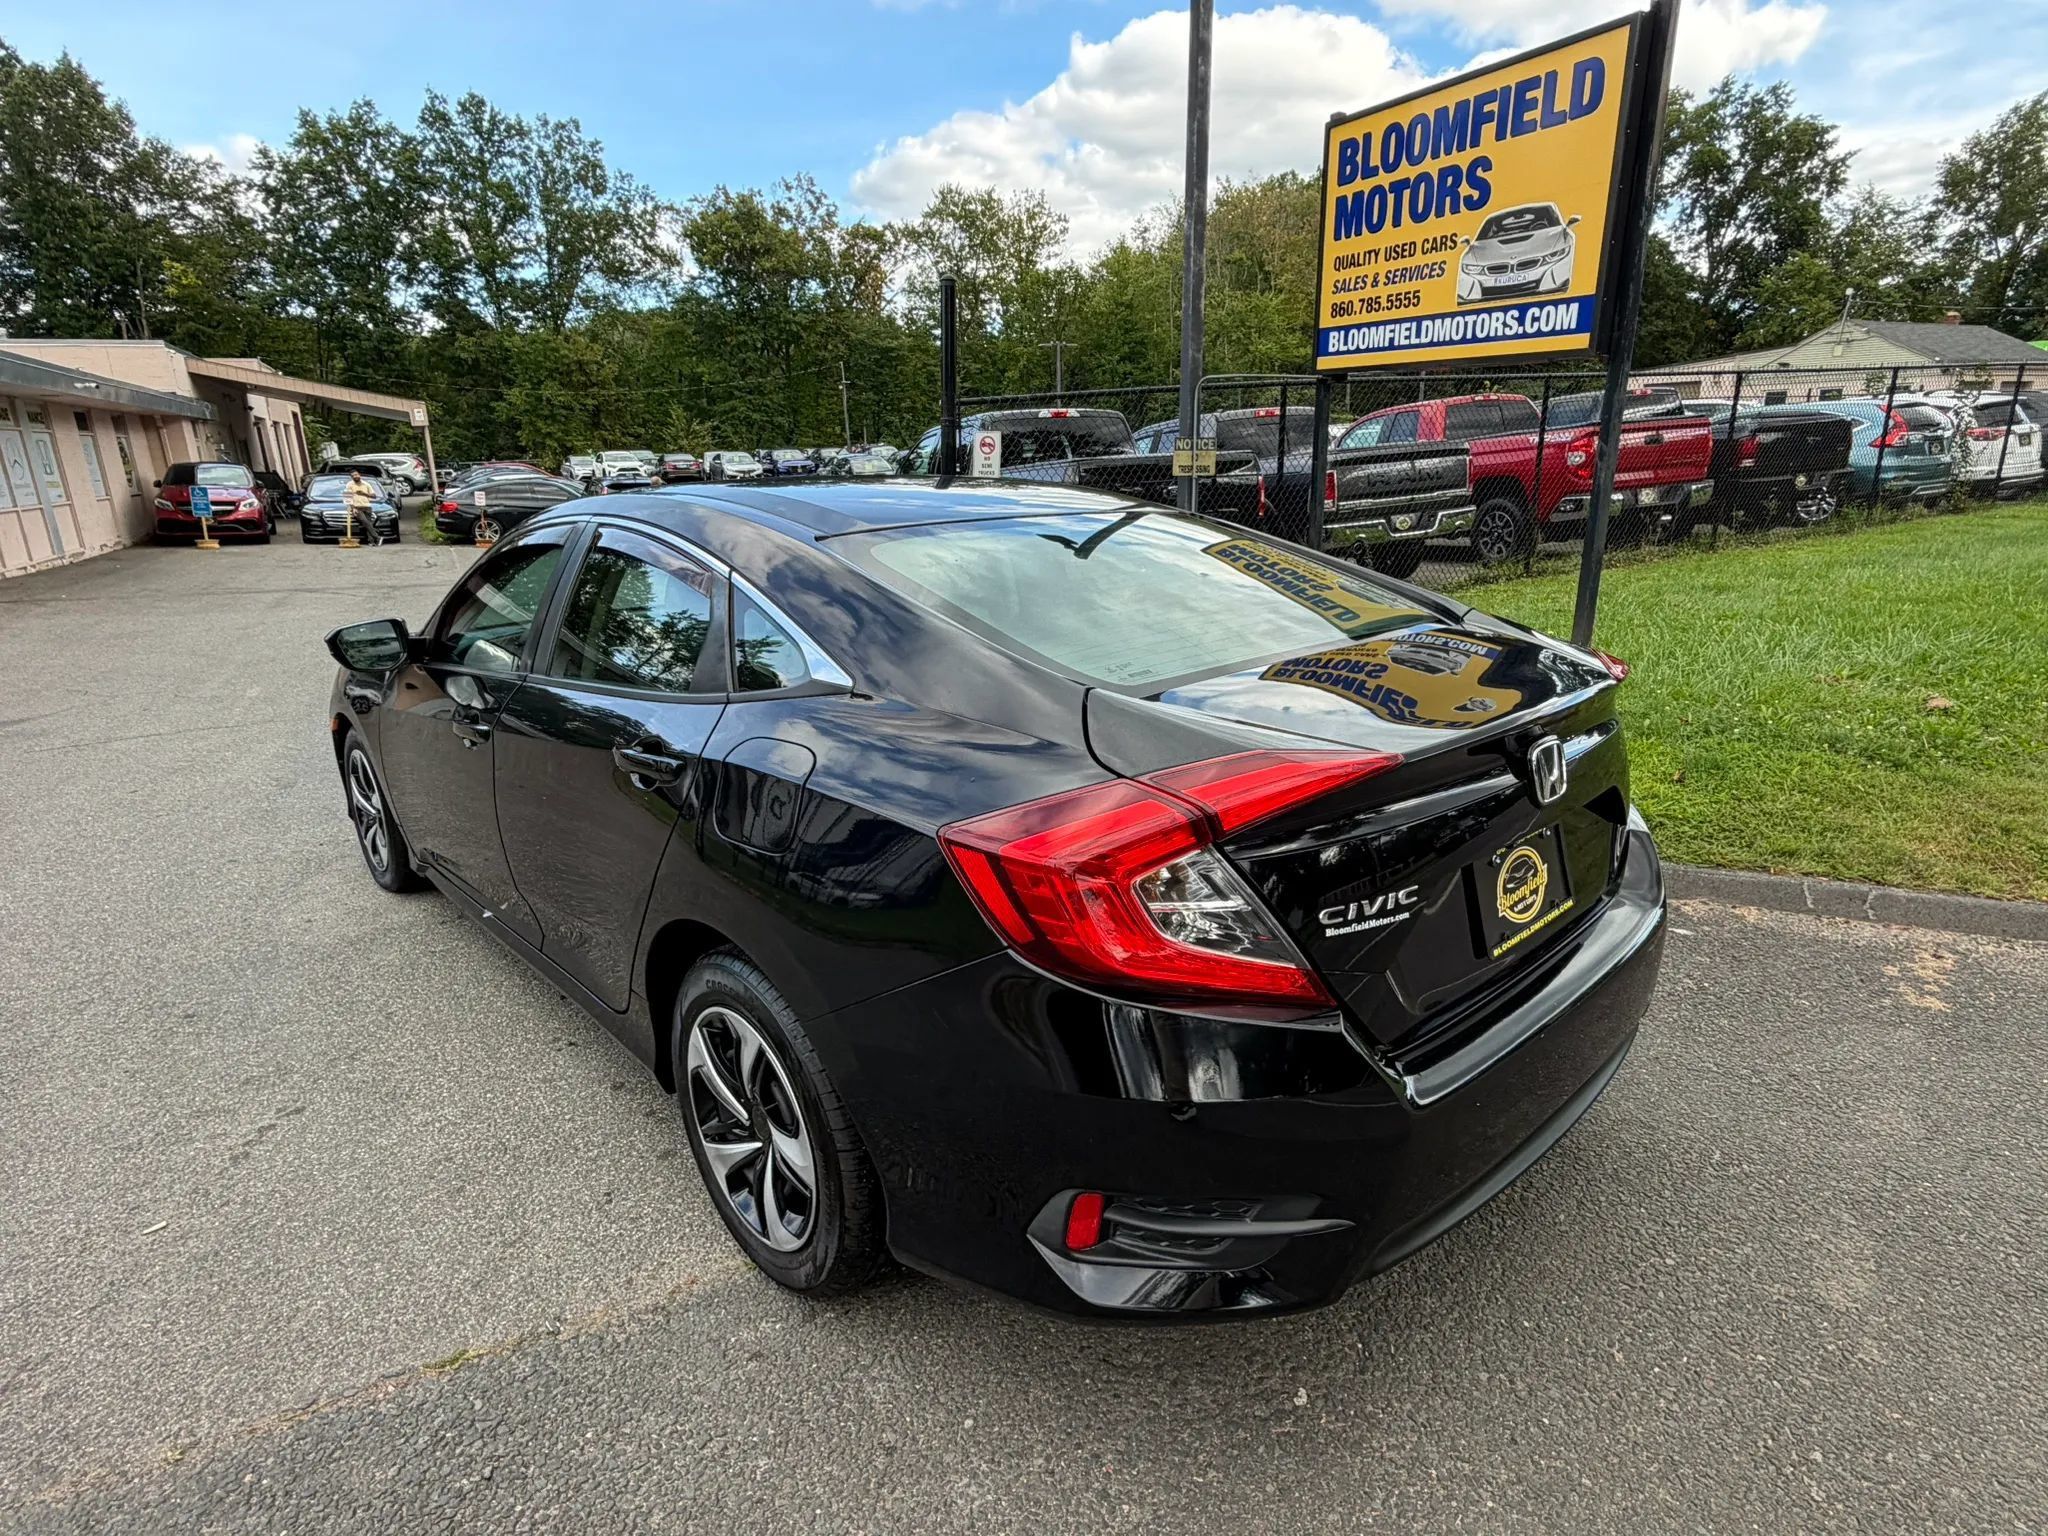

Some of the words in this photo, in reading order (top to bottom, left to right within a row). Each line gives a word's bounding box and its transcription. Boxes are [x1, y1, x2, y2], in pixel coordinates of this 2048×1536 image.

[1337, 56, 1606, 187] BLOOMFIELD
[1333, 155, 1493, 241] MOTORS
[1333, 248, 1381, 272] QUALITY
[1384, 241, 1417, 262] USED
[1421, 233, 1458, 255] CARS
[1332, 274, 1368, 295] SALES
[1371, 272, 1380, 288] &
[1383, 260, 1447, 286] SERVICES
[1330, 290, 1421, 318] 860.785.5555
[1328, 302, 1580, 352] BLOOMFIELDMOTORS.COM
[1175, 438, 1215, 450] NOICE
[1319, 885, 1419, 925] CIVIC
[1500, 871, 1546, 911] Bloomfield
[1513, 894, 1537, 912] MOTORS
[1325, 912, 1410, 937] BloomfieldMotors.com
[1493, 899, 1574, 957] BLOOMFIELDMOTORS.COM
